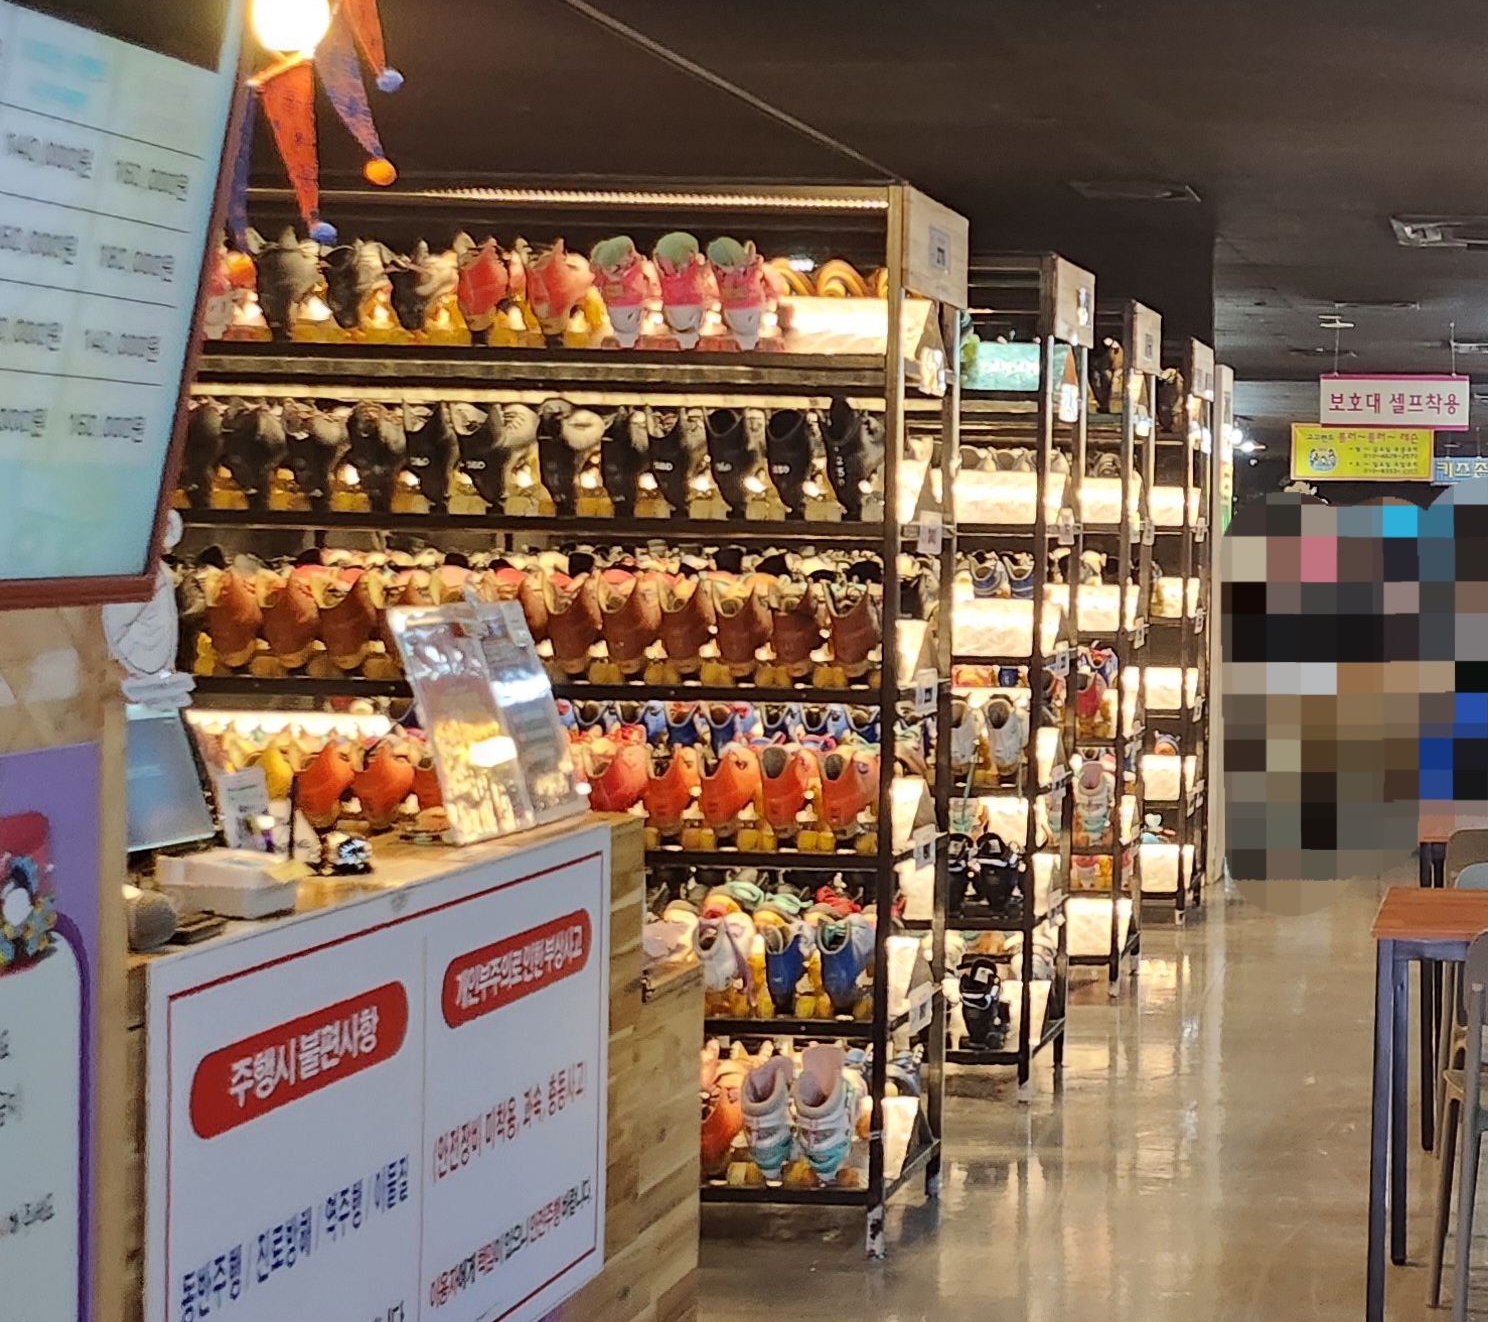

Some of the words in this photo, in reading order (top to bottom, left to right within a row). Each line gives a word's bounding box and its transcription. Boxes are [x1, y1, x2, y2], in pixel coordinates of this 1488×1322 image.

[1328, 392, 1381, 414] 보호대
[1389, 392, 1460, 415] 셀프착용
[257, 1206, 312, 1284] 진로방해
[325, 1177, 363, 1243] 역주행
